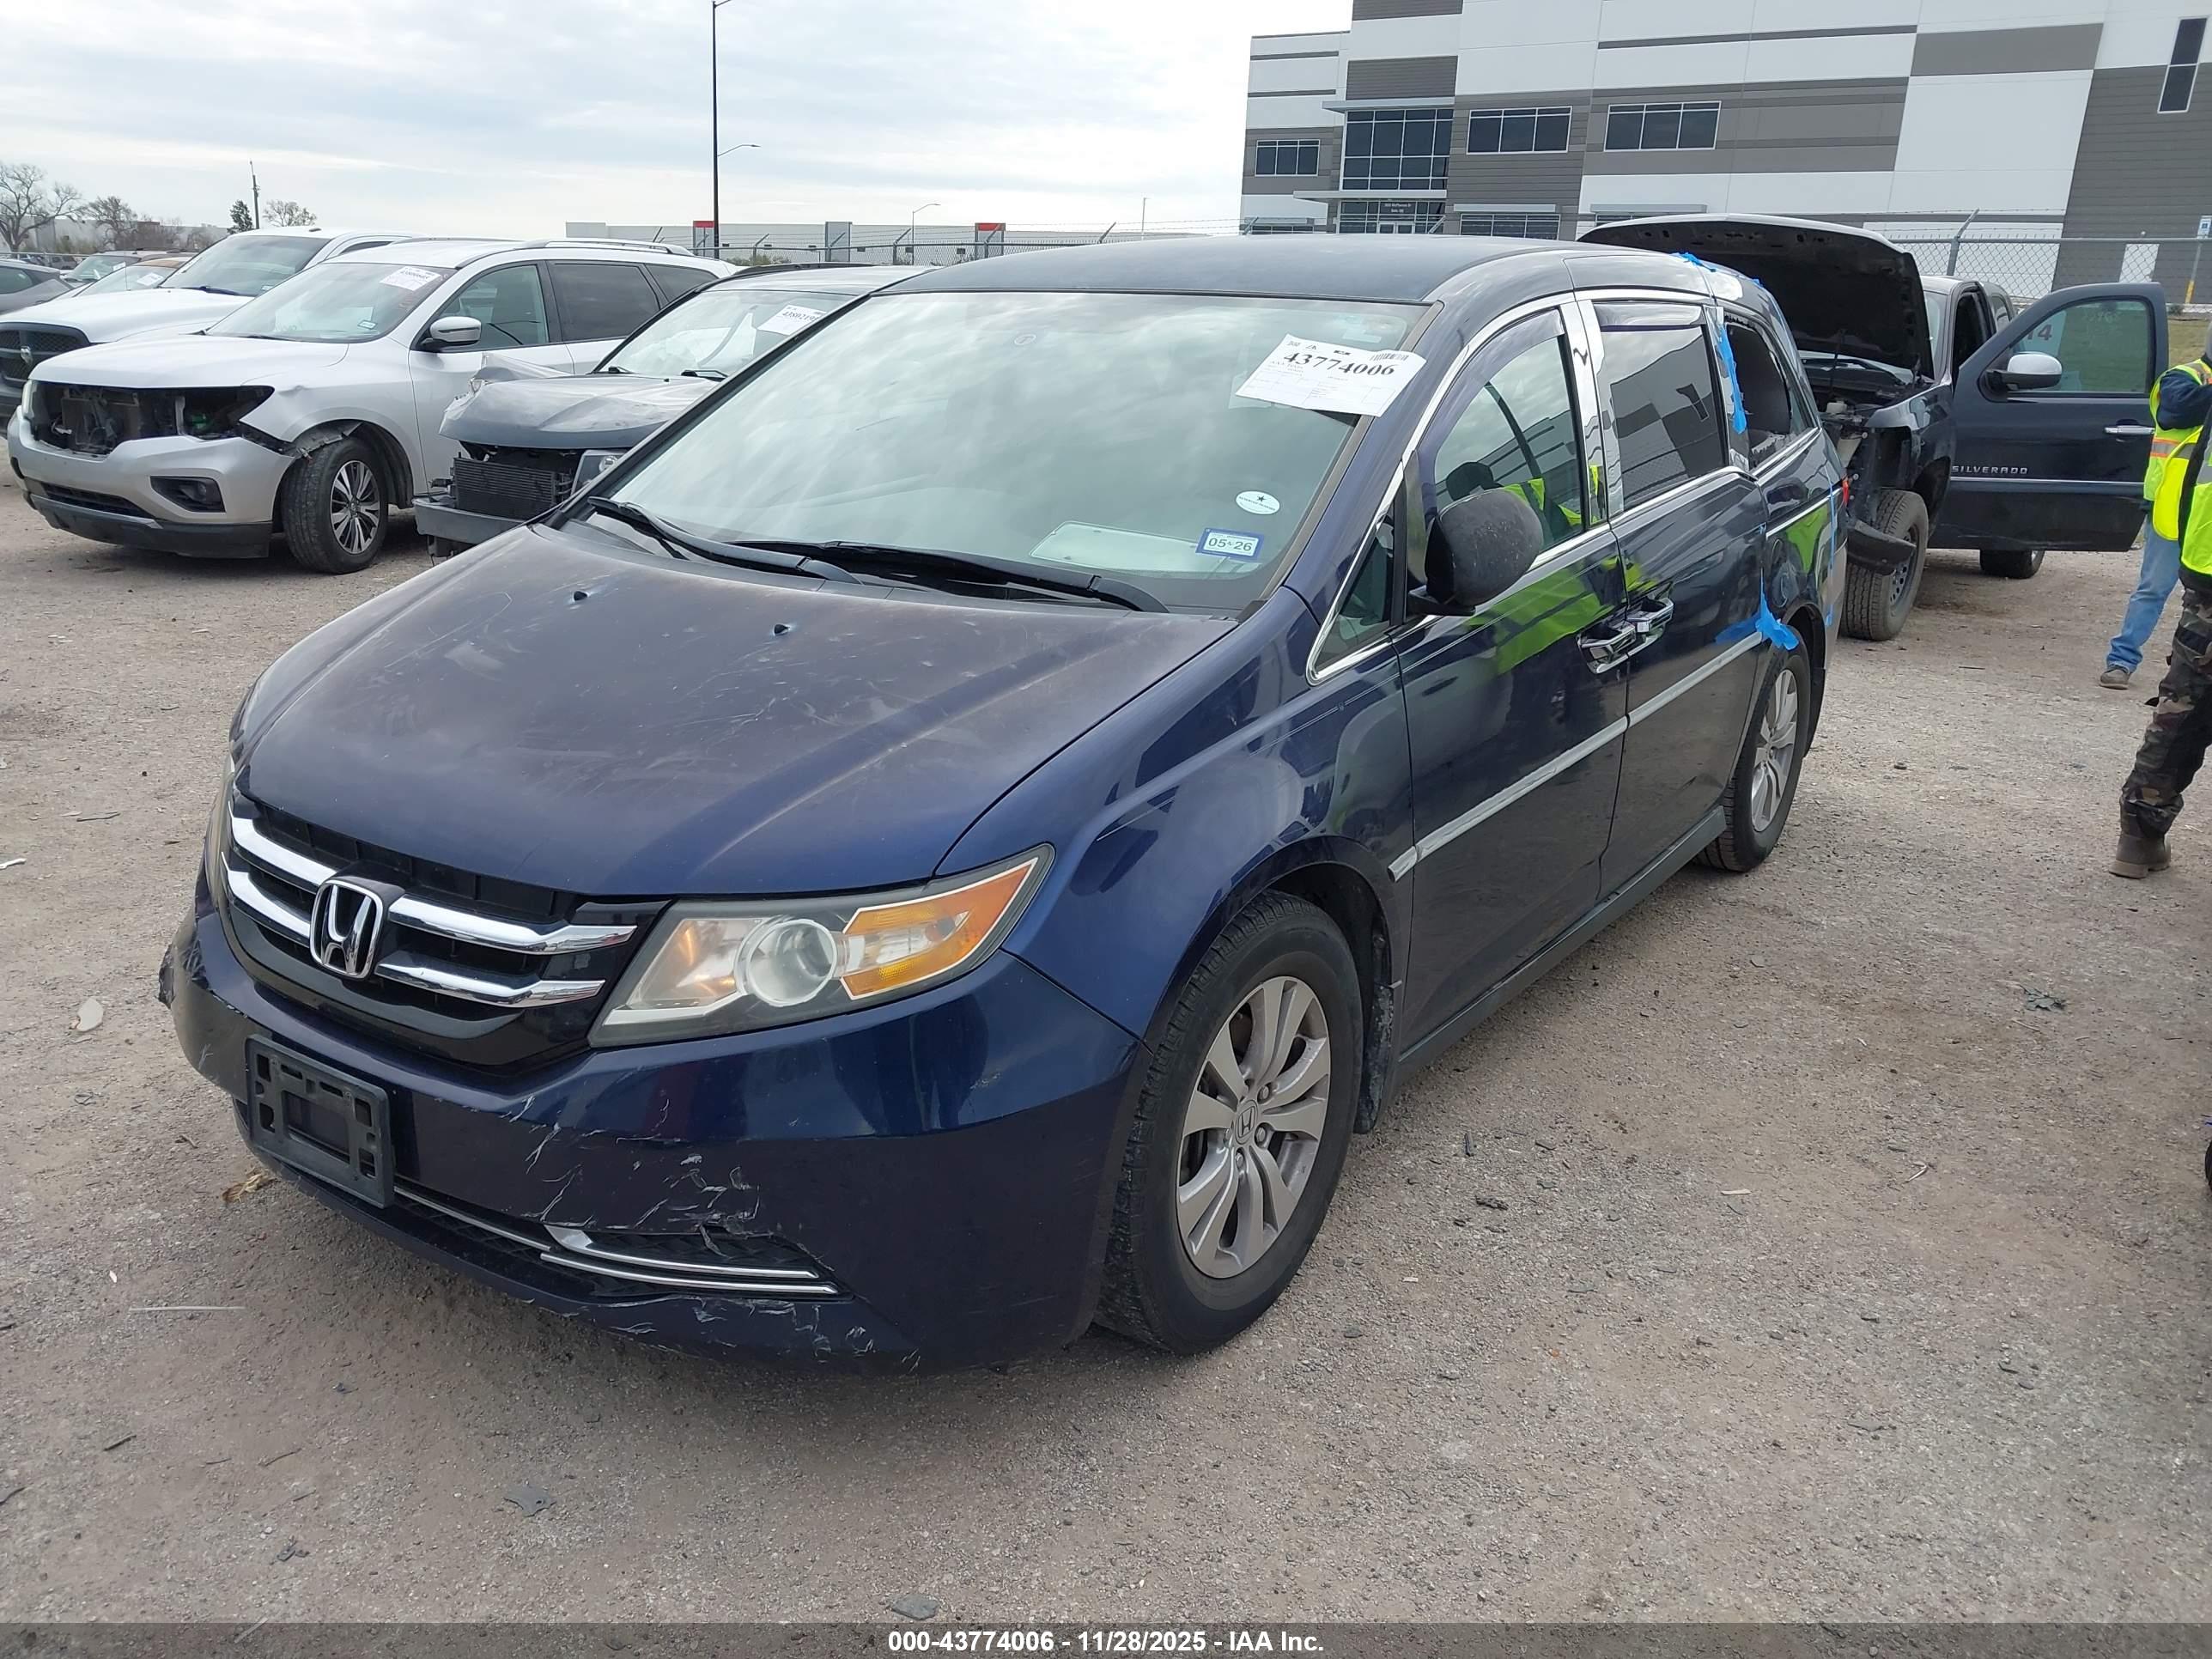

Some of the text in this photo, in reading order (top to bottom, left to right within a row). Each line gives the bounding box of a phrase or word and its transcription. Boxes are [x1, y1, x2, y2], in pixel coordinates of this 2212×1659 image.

[1284, 352, 1397, 376] 43774006
[1951, 465, 2028, 475] SILVERADO
[1207, 538, 1254, 551] 05 26
